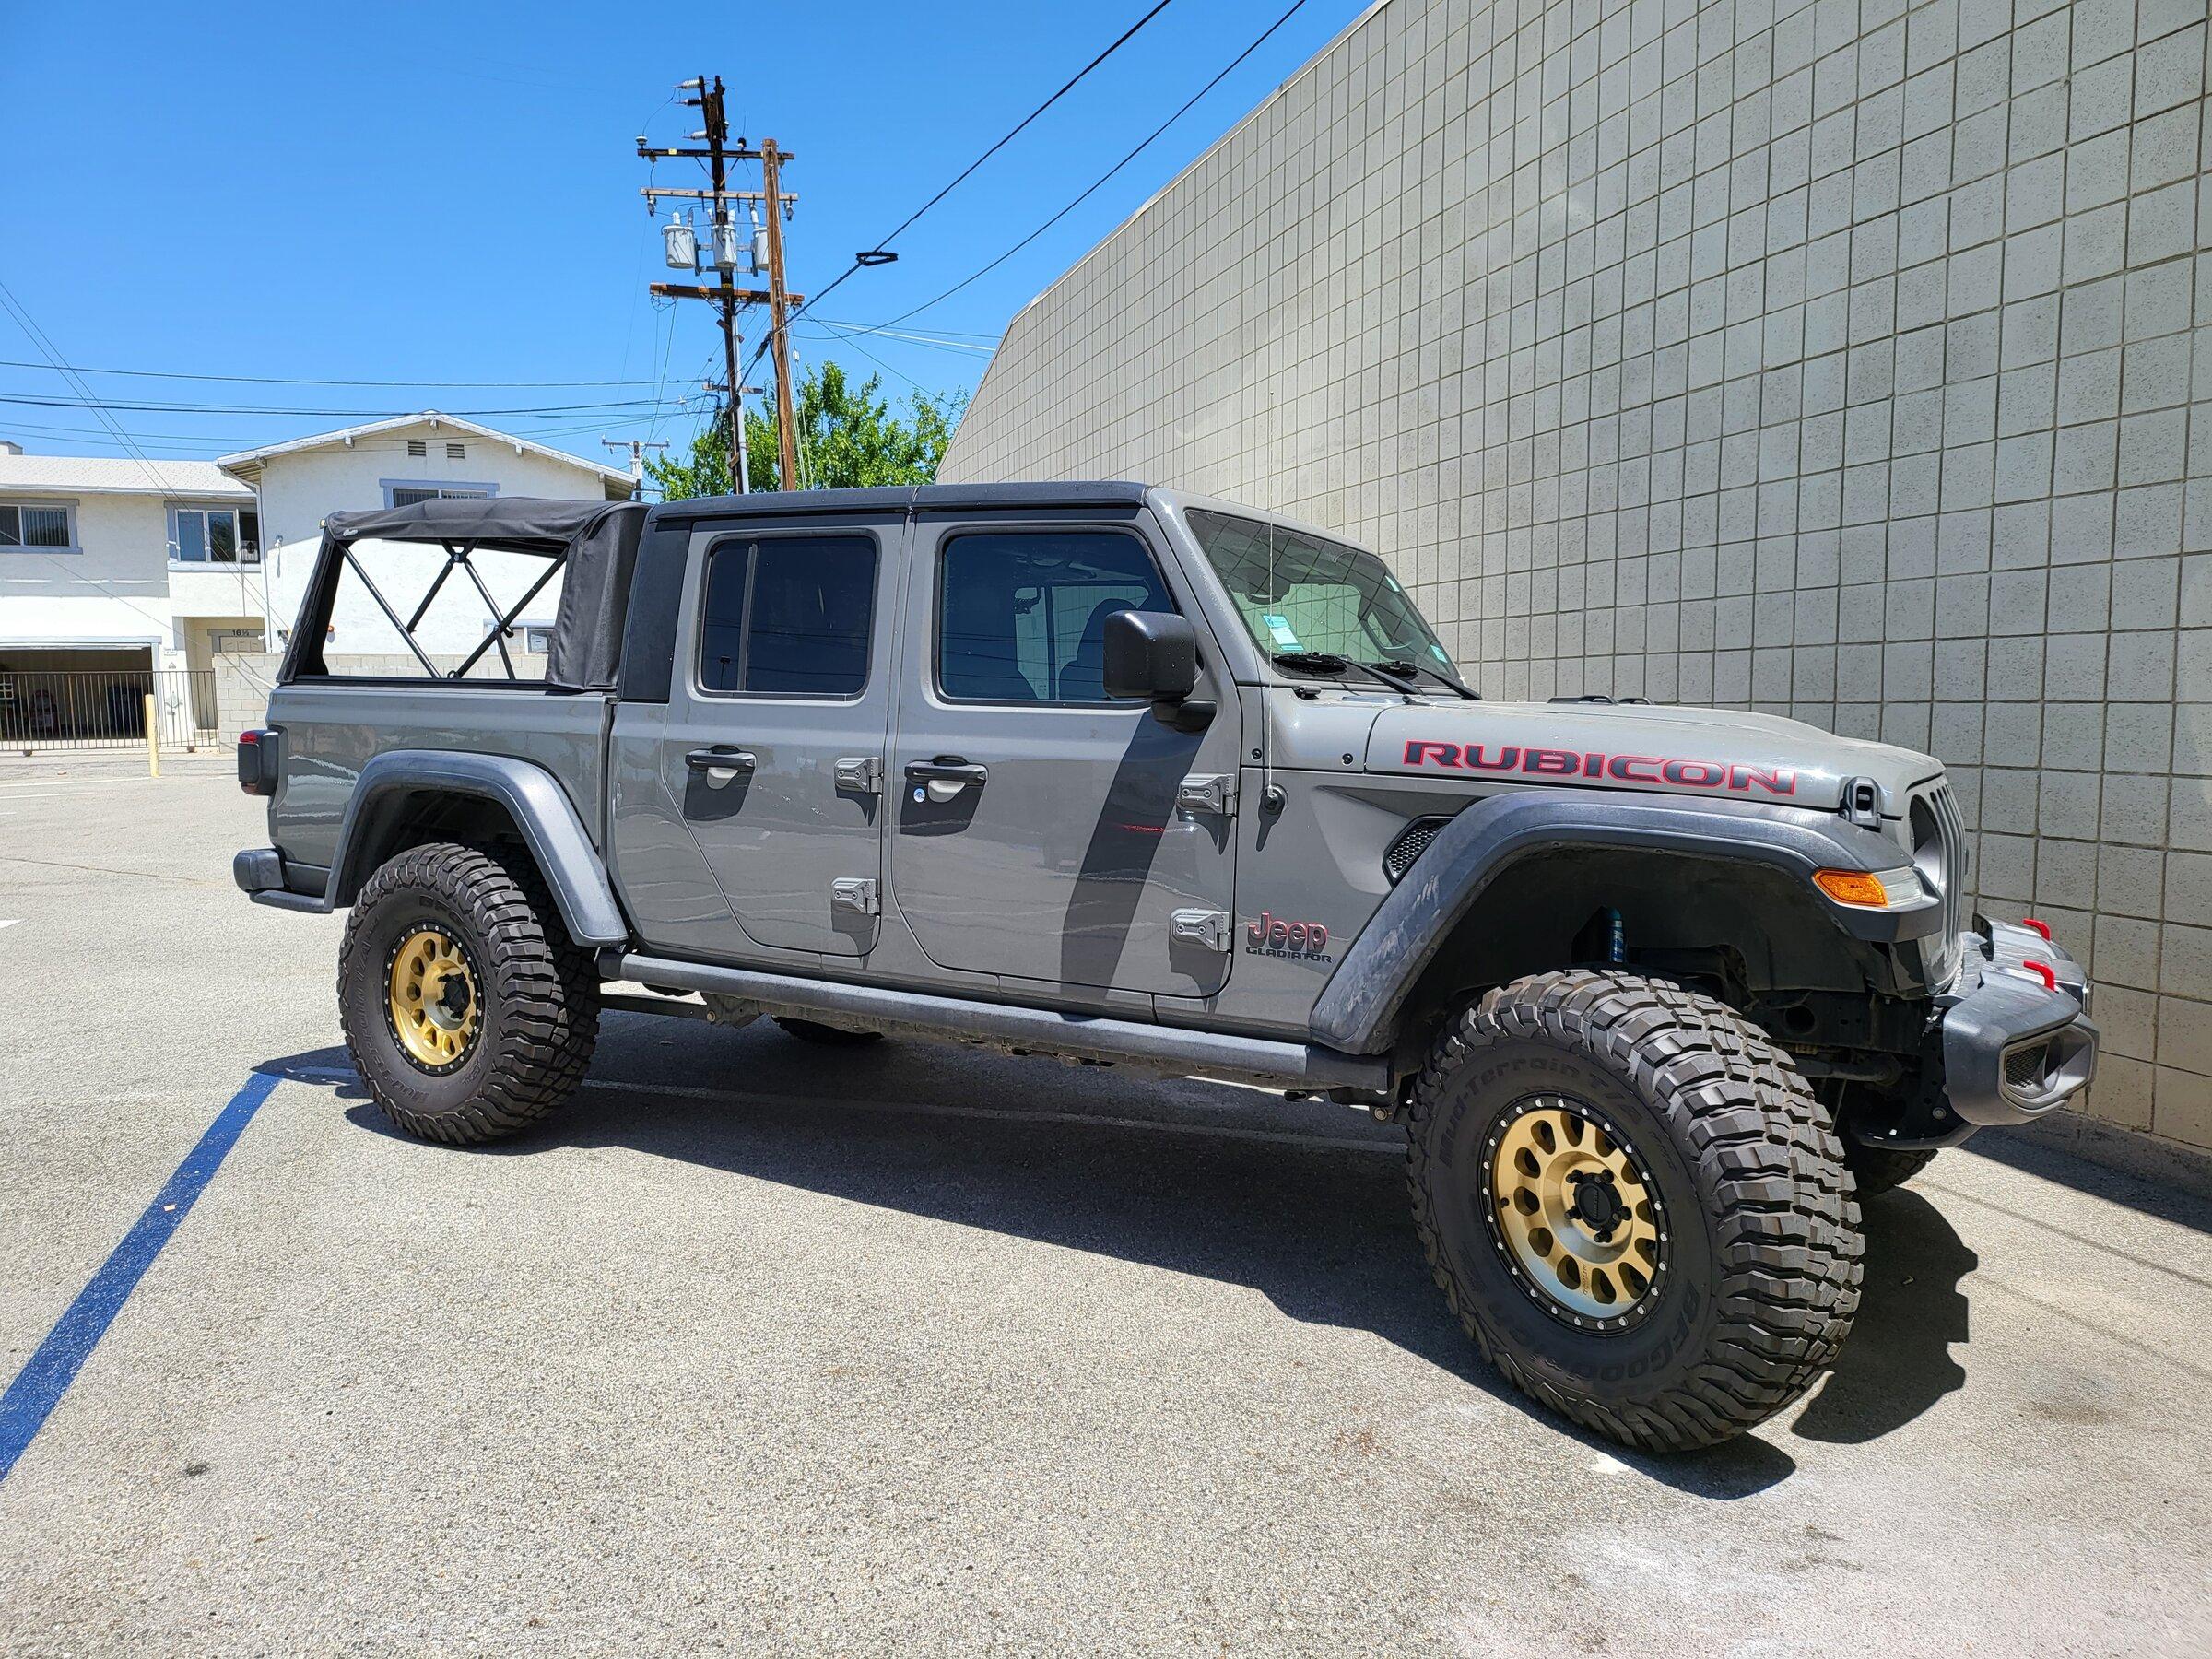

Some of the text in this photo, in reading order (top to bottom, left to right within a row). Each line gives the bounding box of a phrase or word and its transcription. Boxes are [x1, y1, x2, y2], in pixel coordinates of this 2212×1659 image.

[1404, 740, 1796, 795] RUBICON
[1248, 910, 1327, 951] Jeep
[1245, 946, 1333, 963] GLADIATOR
